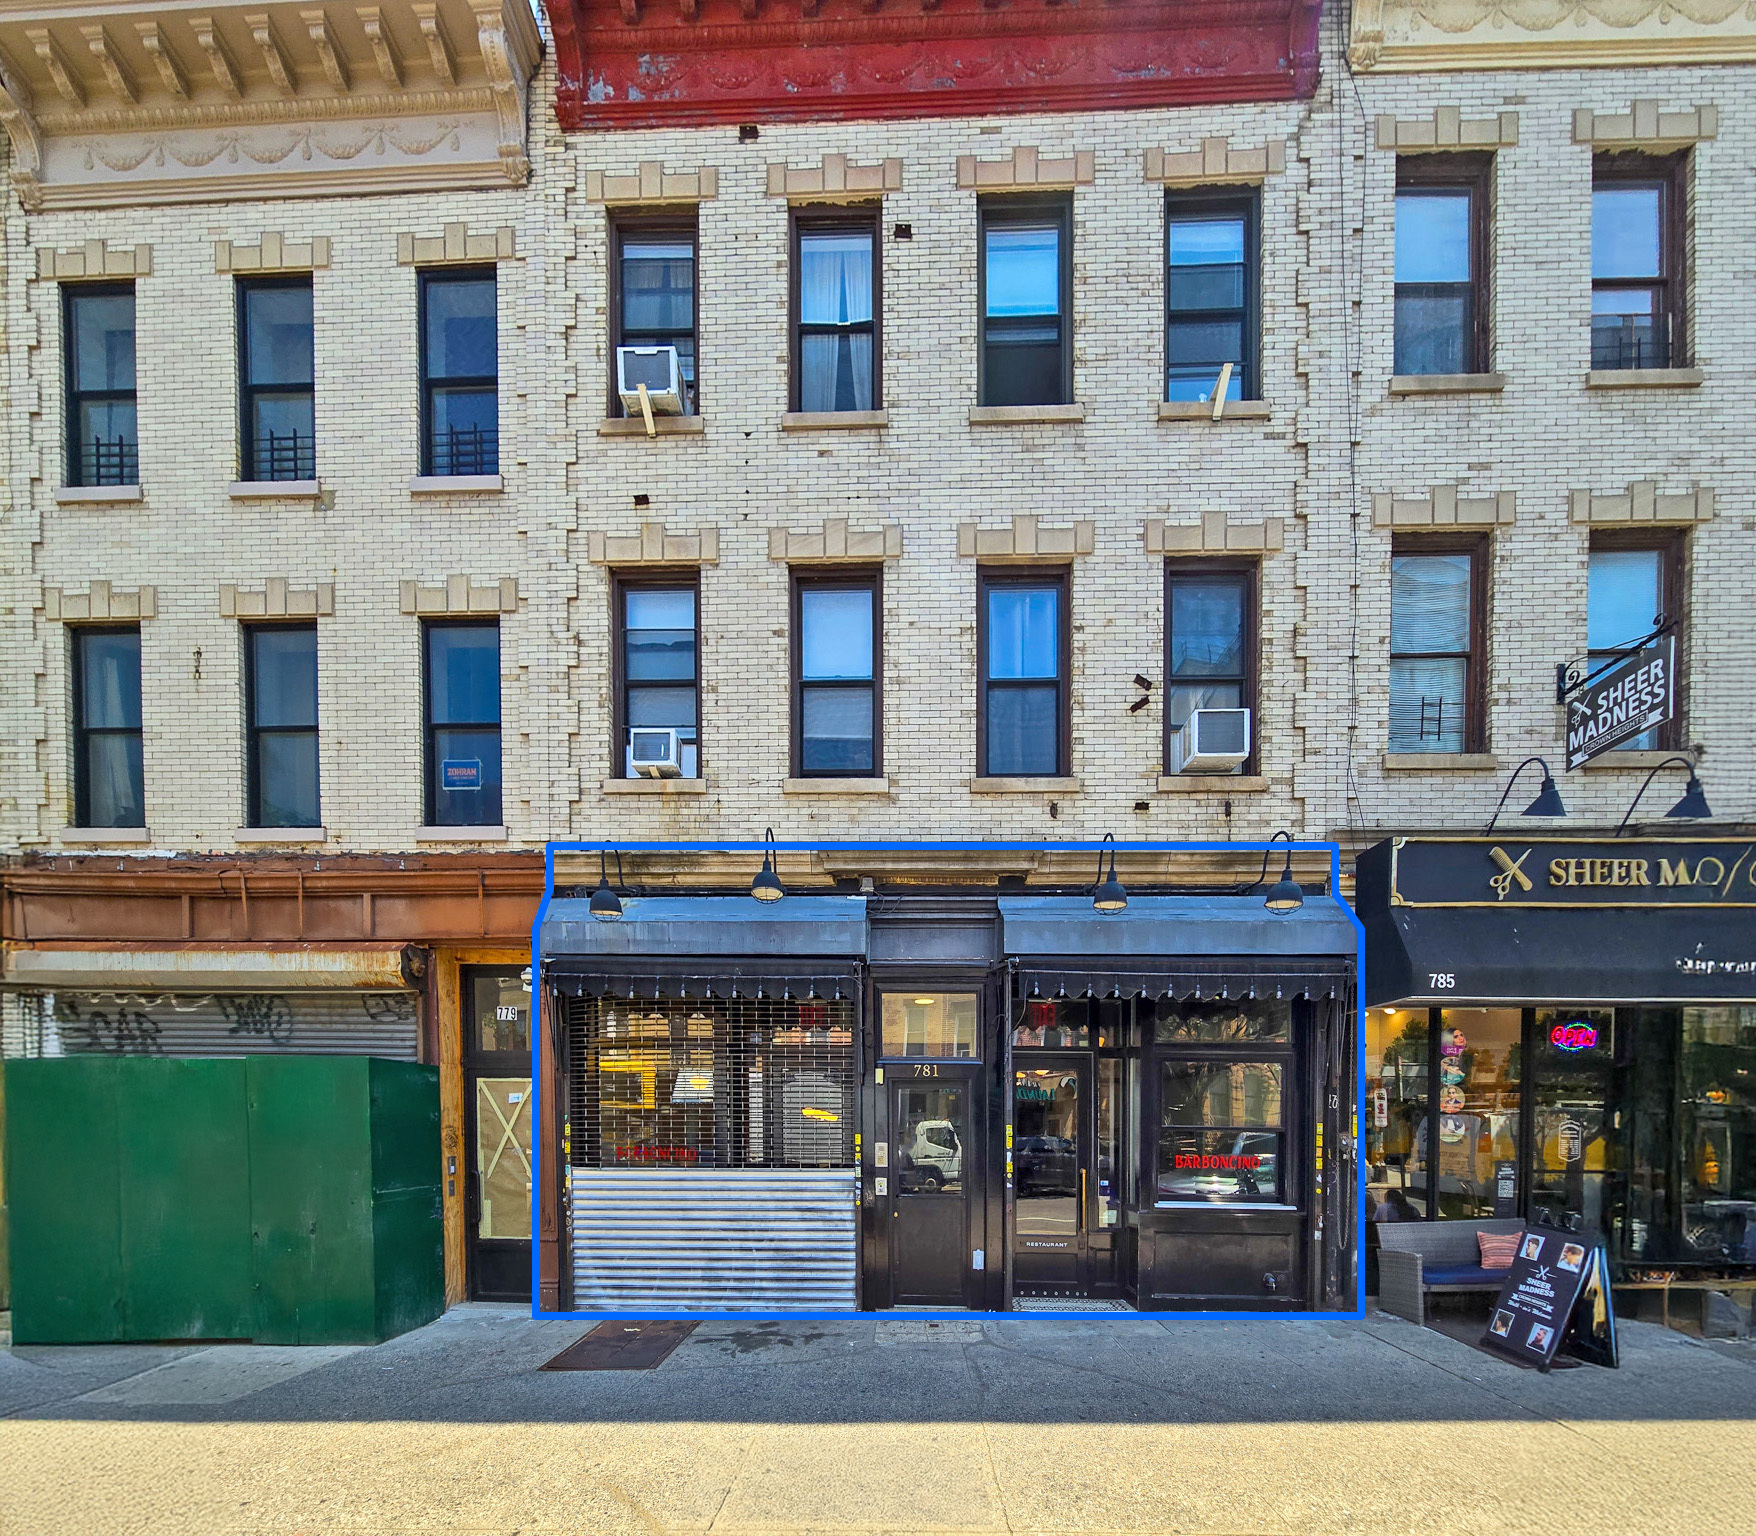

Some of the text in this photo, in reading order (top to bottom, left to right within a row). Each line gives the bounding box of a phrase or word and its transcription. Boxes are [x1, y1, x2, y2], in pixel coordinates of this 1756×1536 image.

[1597, 658, 1664, 714] SHEER
[1569, 679, 1665, 752] MADNESS
[1584, 714, 1645, 753] CROWN HEIGHTS
[447, 768, 477, 776] ZOHRAN
[1549, 858, 1651, 886] SHEER
[1429, 973, 1456, 989] 785
[497, 1007, 517, 1019] 779
[1551, 1025, 1597, 1047] OPEN
[913, 1064, 939, 1077] 781
[616, 1146, 698, 1160] BARBONCINO
[1175, 1154, 1261, 1169] BARBONCINO
[1518, 1284, 1555, 1297] MADNESS
[1526, 1277, 1552, 1290] SHEER
